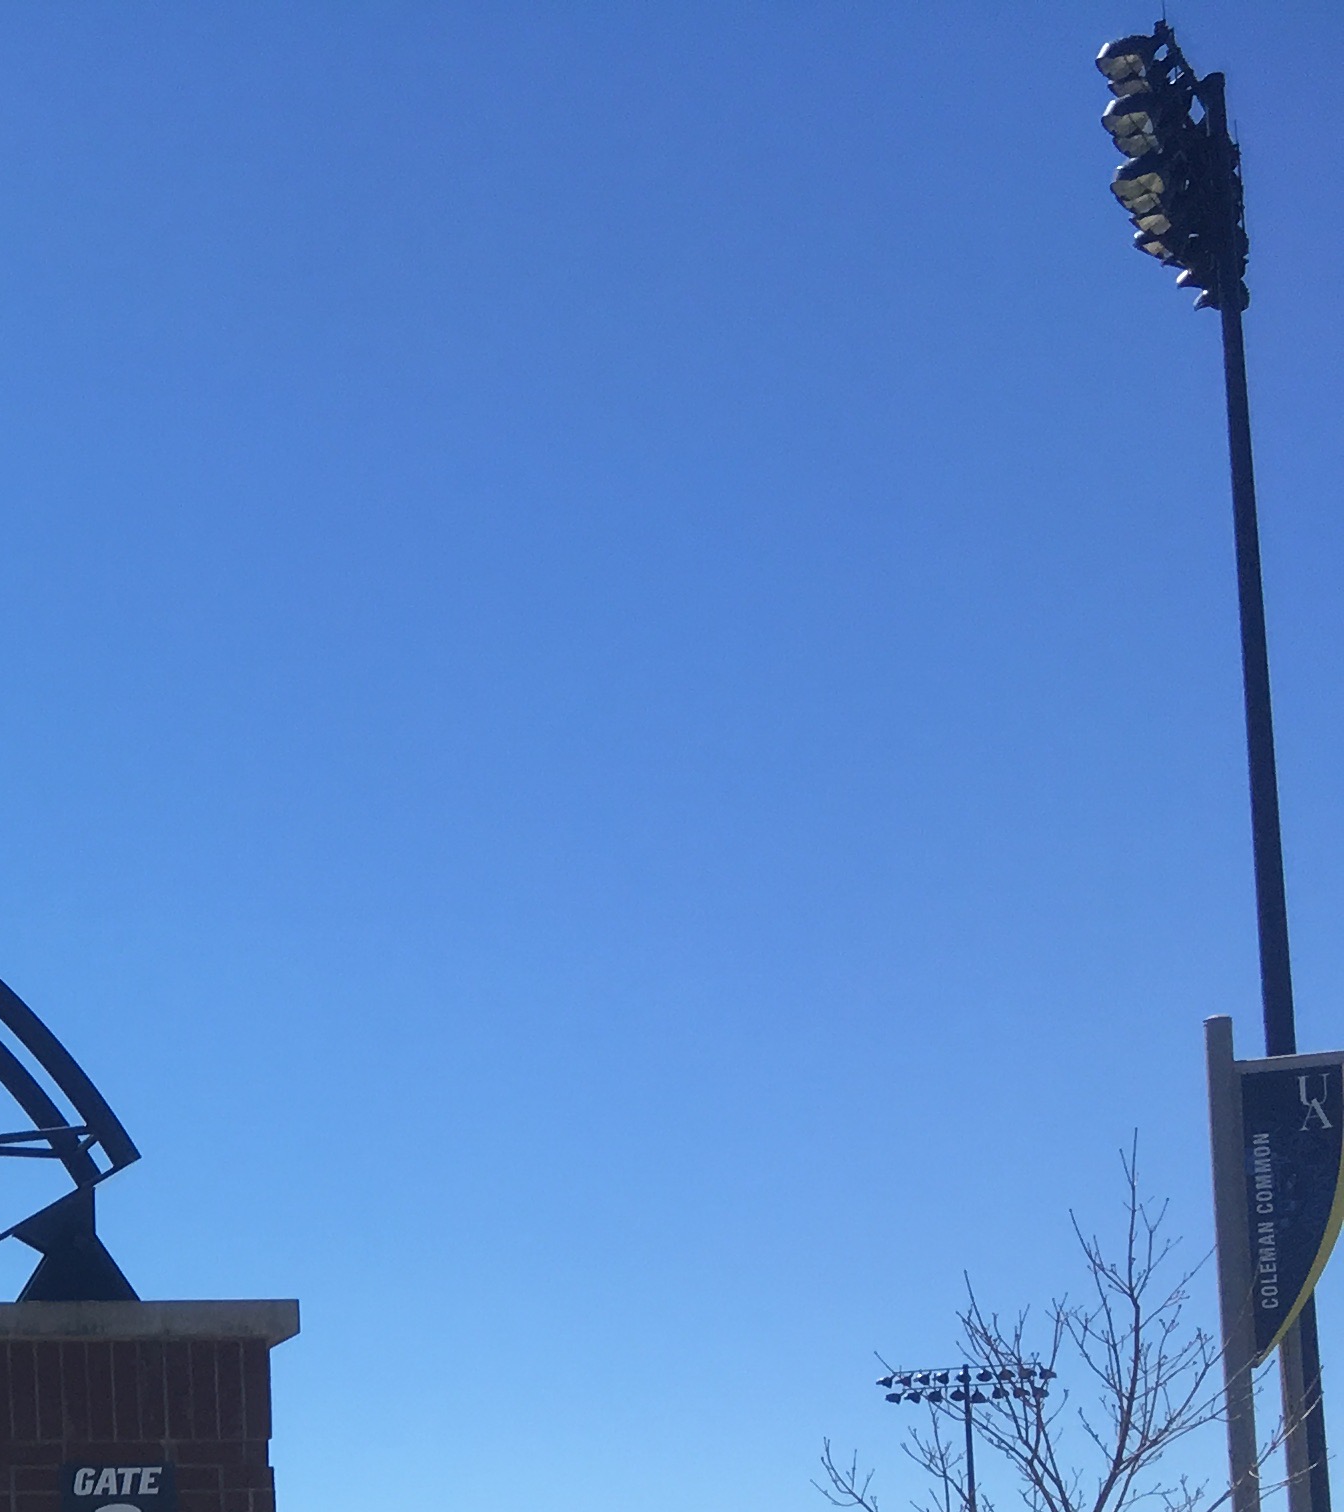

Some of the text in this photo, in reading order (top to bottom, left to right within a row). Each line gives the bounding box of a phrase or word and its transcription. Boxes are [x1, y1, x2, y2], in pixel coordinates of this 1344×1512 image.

[1253, 1133, 1279, 1309] COLEMAN COMMON
[73, 1467, 162, 1496] GATE
